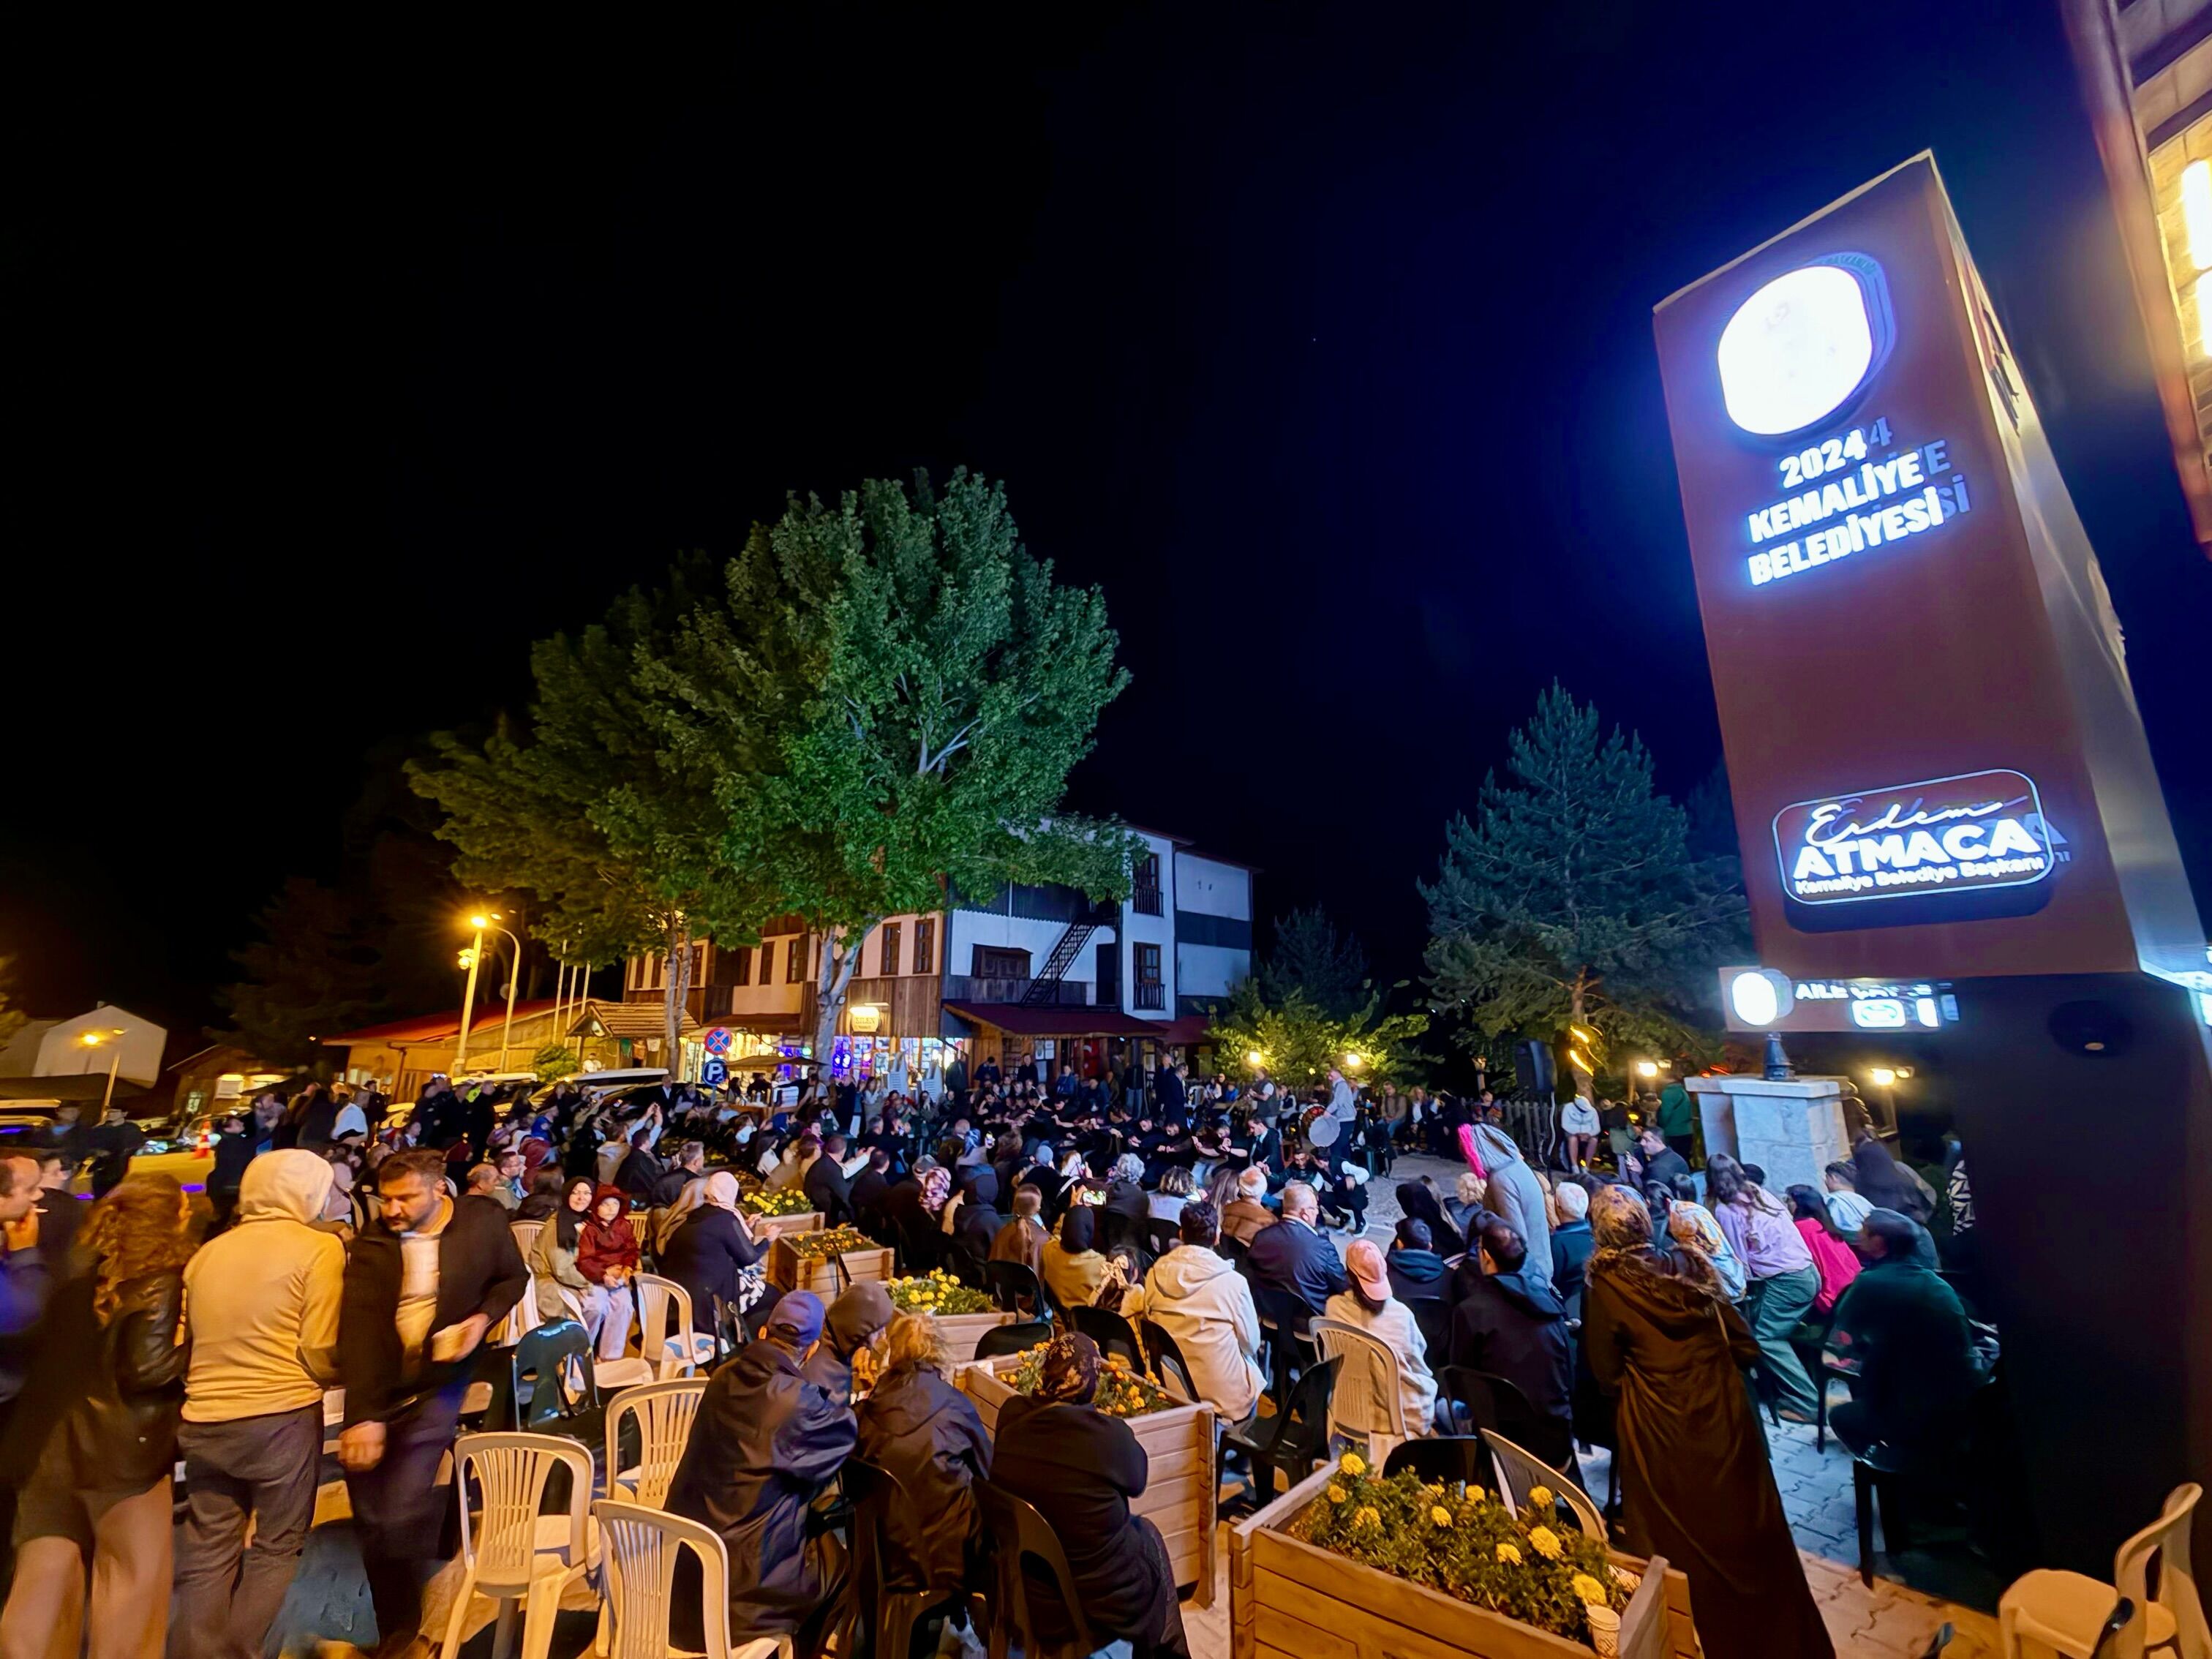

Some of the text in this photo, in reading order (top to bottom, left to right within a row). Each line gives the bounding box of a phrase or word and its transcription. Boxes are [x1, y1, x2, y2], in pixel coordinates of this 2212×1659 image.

[1748, 451, 1925, 543] KEMALİYE
[1747, 486, 1946, 587] BELEDİYESİ
[1793, 818, 2043, 880] ATMACA
[1874, 865, 1957, 887] Belediye
